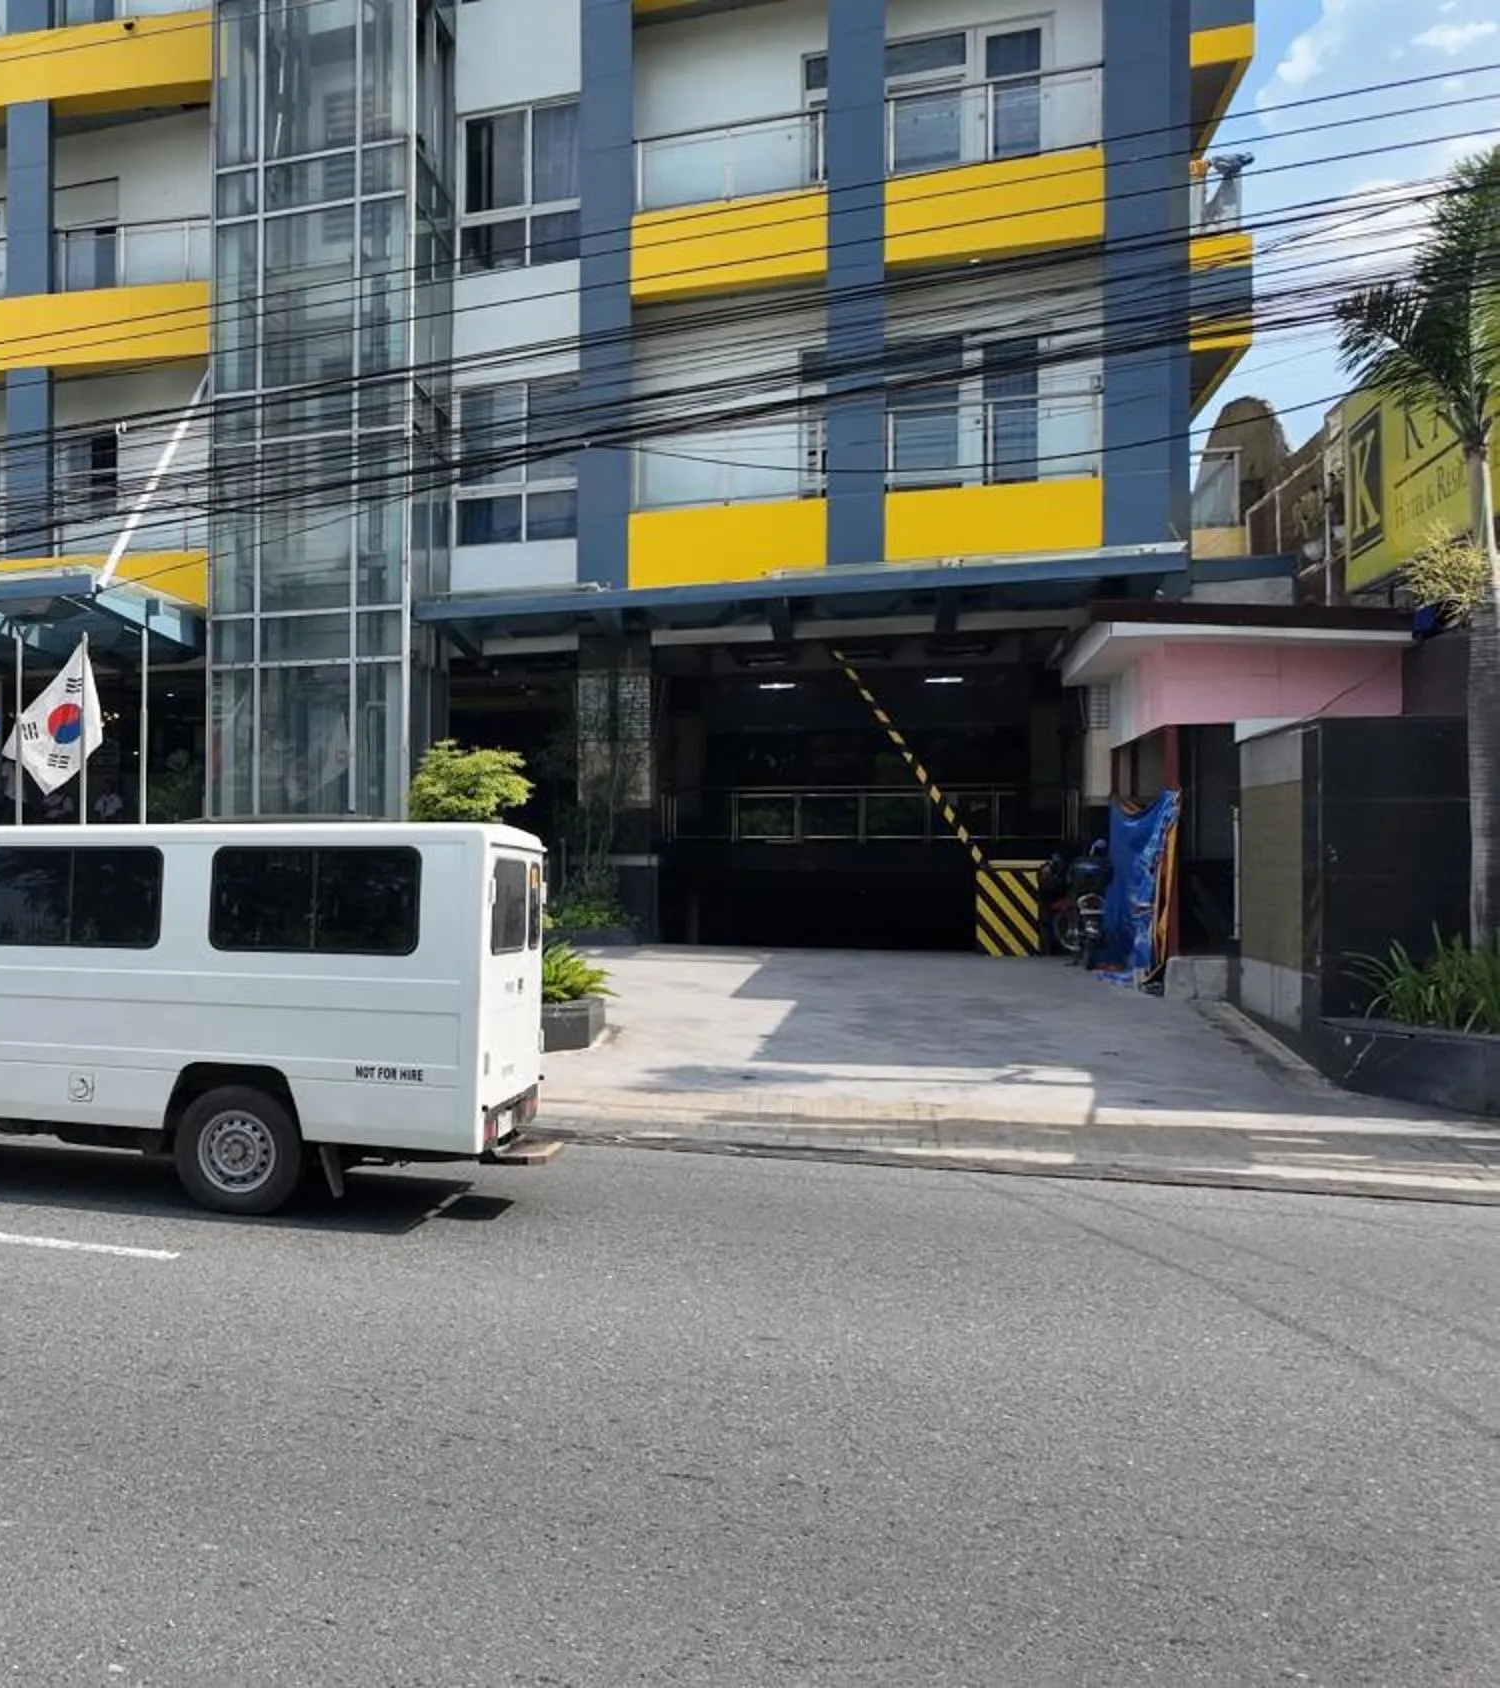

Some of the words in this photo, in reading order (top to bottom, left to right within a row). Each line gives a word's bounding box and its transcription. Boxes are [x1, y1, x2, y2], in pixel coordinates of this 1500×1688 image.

[1349, 429, 1381, 538] K
[355, 1065, 375, 1079] NOT
[377, 1067, 397, 1081] FOR
[399, 1068, 424, 1083] HIRE
